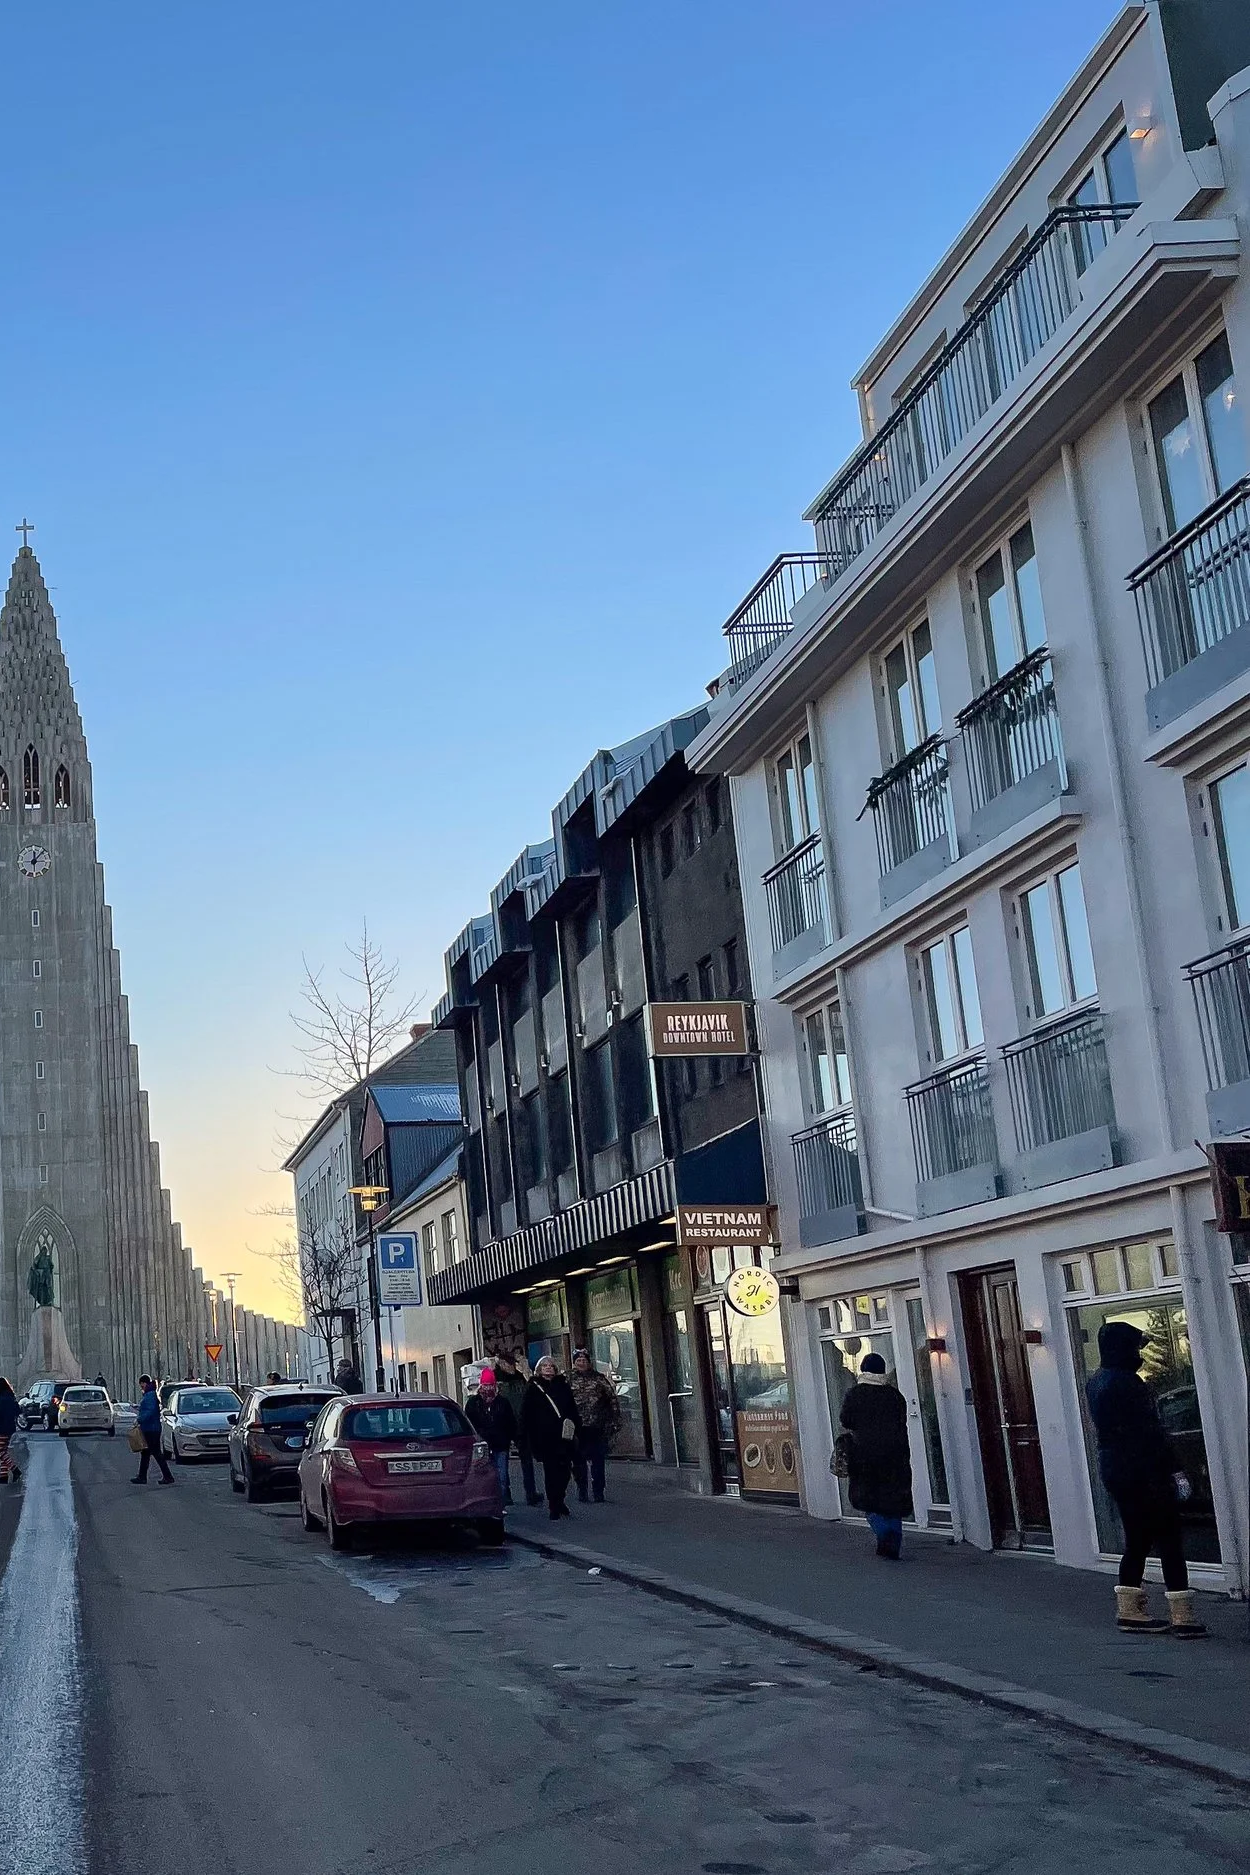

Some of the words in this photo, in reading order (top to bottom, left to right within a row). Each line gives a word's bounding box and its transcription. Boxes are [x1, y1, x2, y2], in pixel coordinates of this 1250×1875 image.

[667, 1014, 728, 1031] REYKJAVIK
[663, 1031, 708, 1044] DOWNTOWN
[711, 1031, 735, 1043] HOTEL
[684, 1212, 762, 1225] VIETNAM
[685, 1228, 762, 1237] RESTAURANT
[389, 1242, 405, 1264] P
[733, 1270, 773, 1288] NORDIC
[736, 1294, 775, 1312] WASABI
